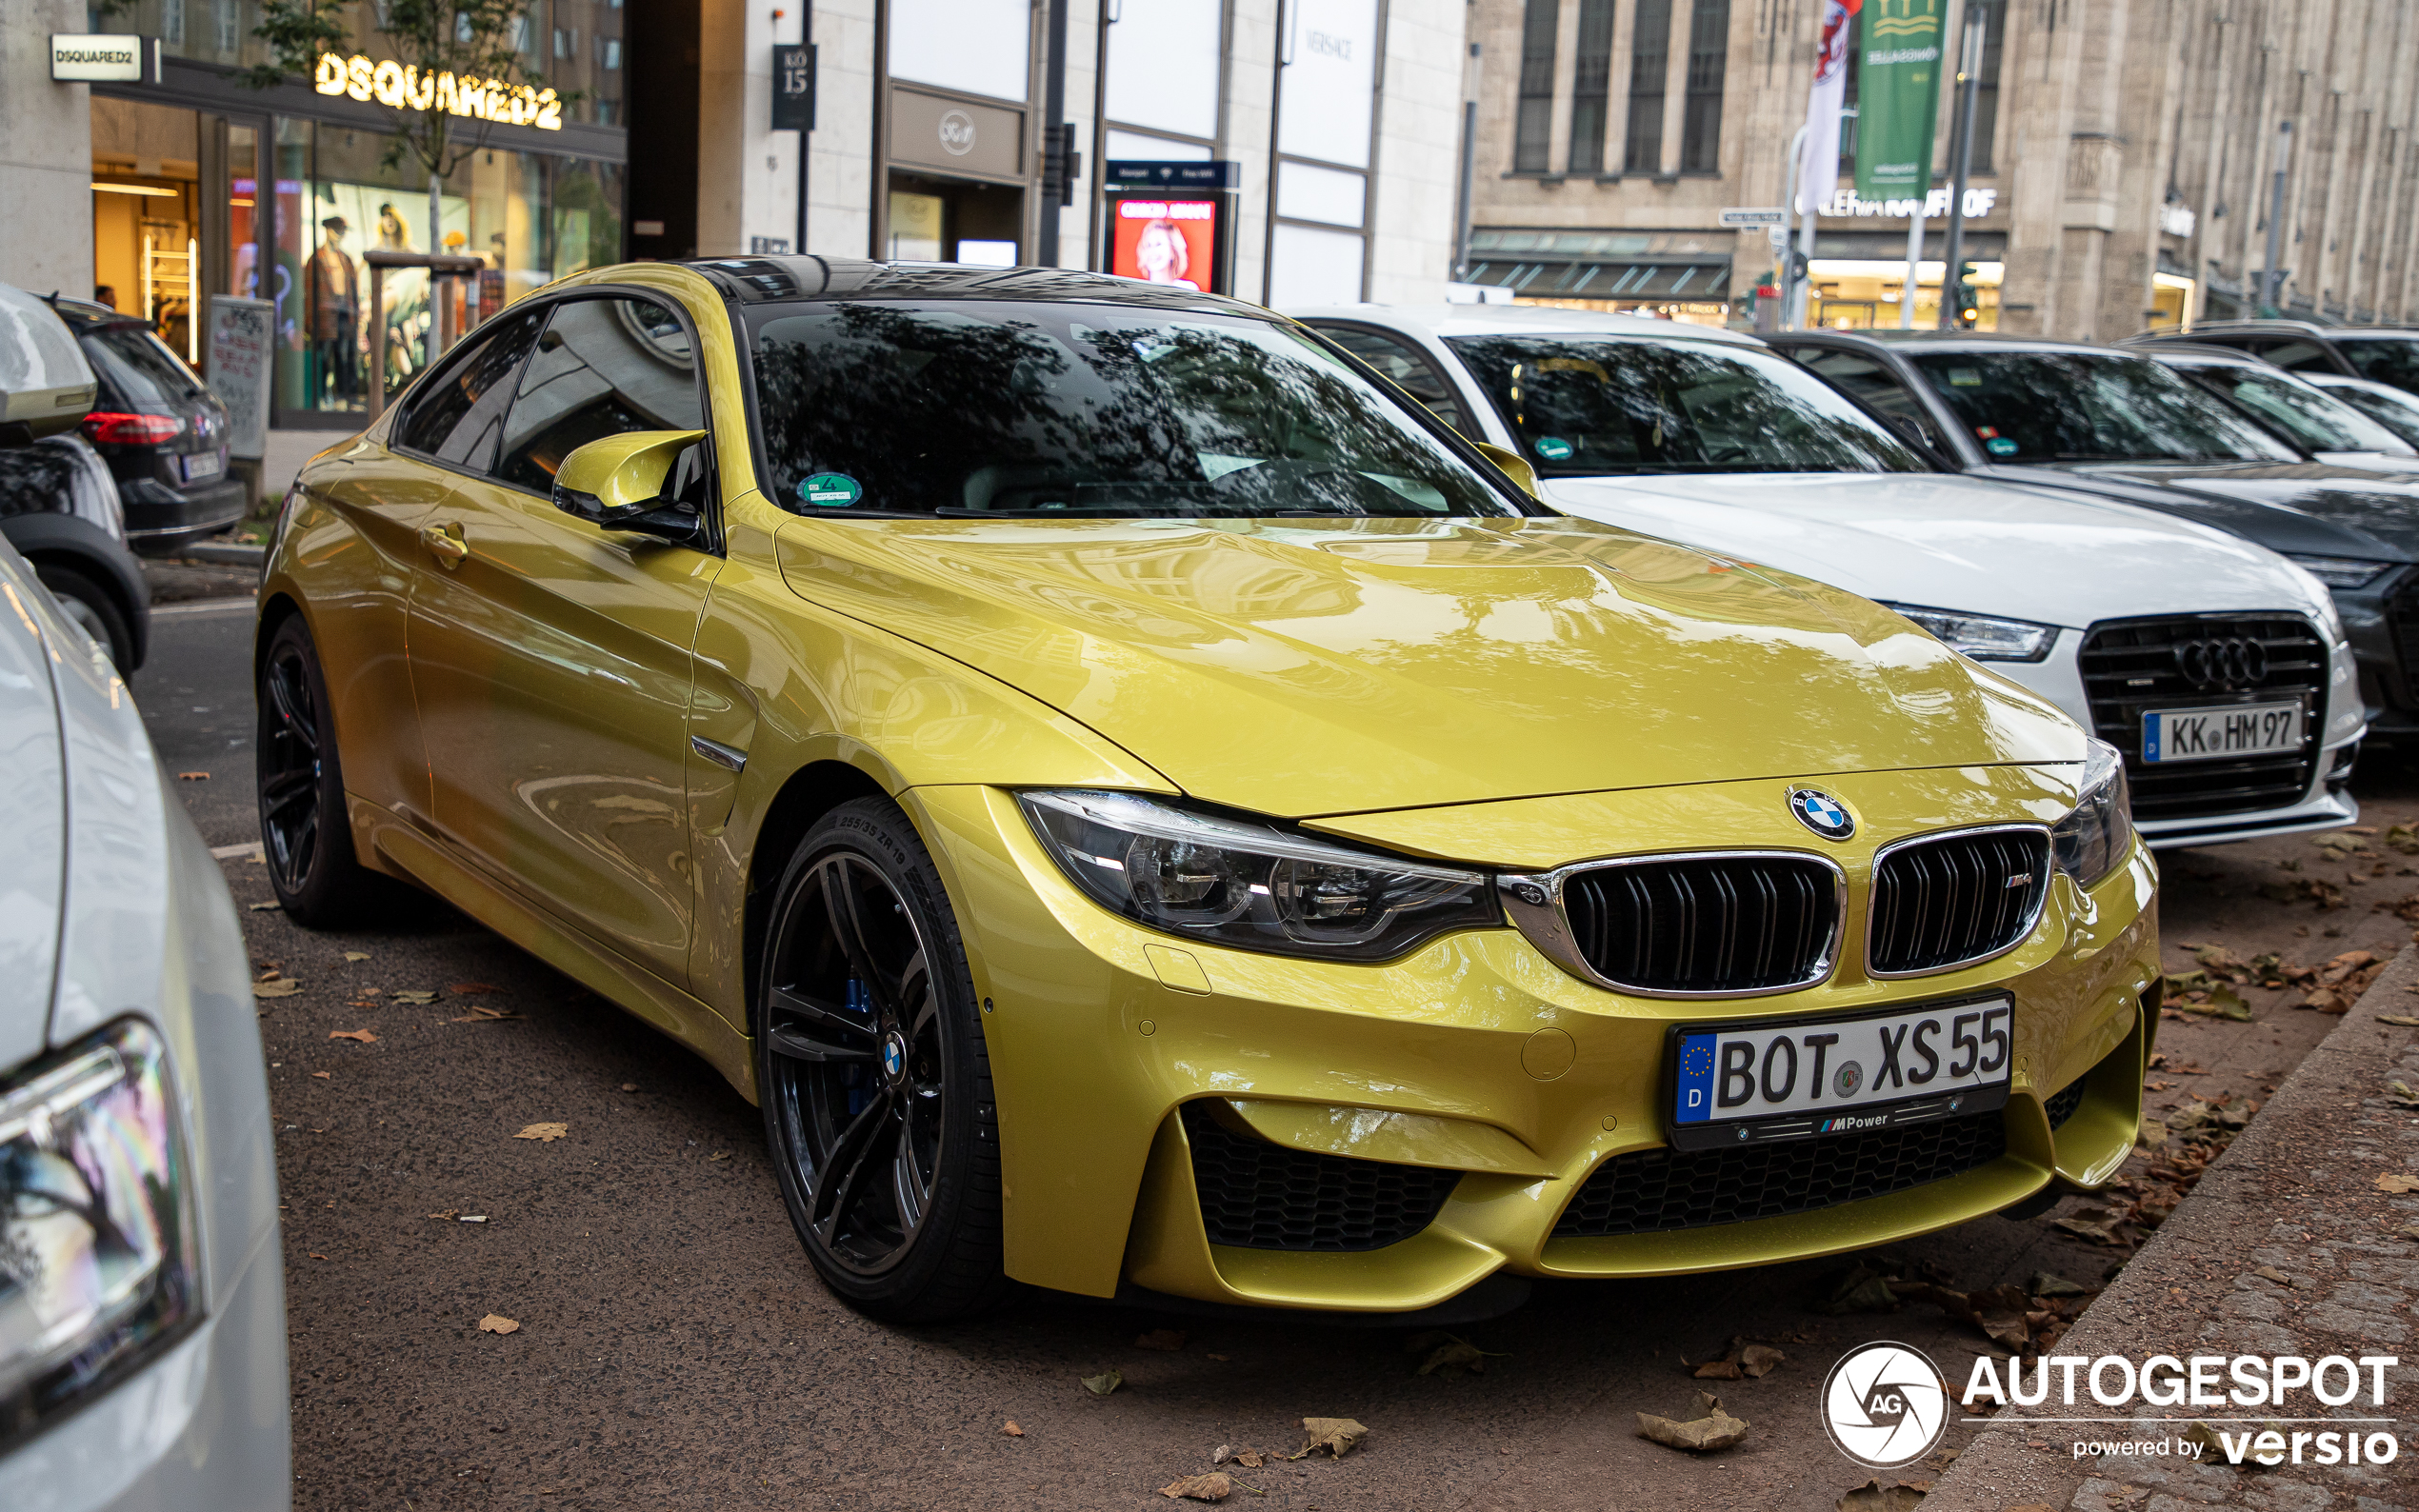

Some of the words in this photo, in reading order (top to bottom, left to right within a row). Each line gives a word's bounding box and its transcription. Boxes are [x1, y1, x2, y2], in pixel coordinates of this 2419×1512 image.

[56, 50, 132, 64] DSQUARED2
[785, 70, 808, 93] 15
[822, 477, 837, 490] 4
[2171, 717, 2207, 754] KK
[2226, 714, 2257, 749] HM
[2264, 711, 2292, 746] 97
[1793, 790, 1836, 806] BMW
[840, 817, 878, 837] 255/35
[877, 831, 893, 850] ZR
[893, 848, 906, 865] 19
[1718, 1033, 1839, 1108] BOT
[1872, 1019, 1941, 1091] XS
[1950, 1007, 2009, 1078] 55
[1688, 1088, 1702, 1107] D
